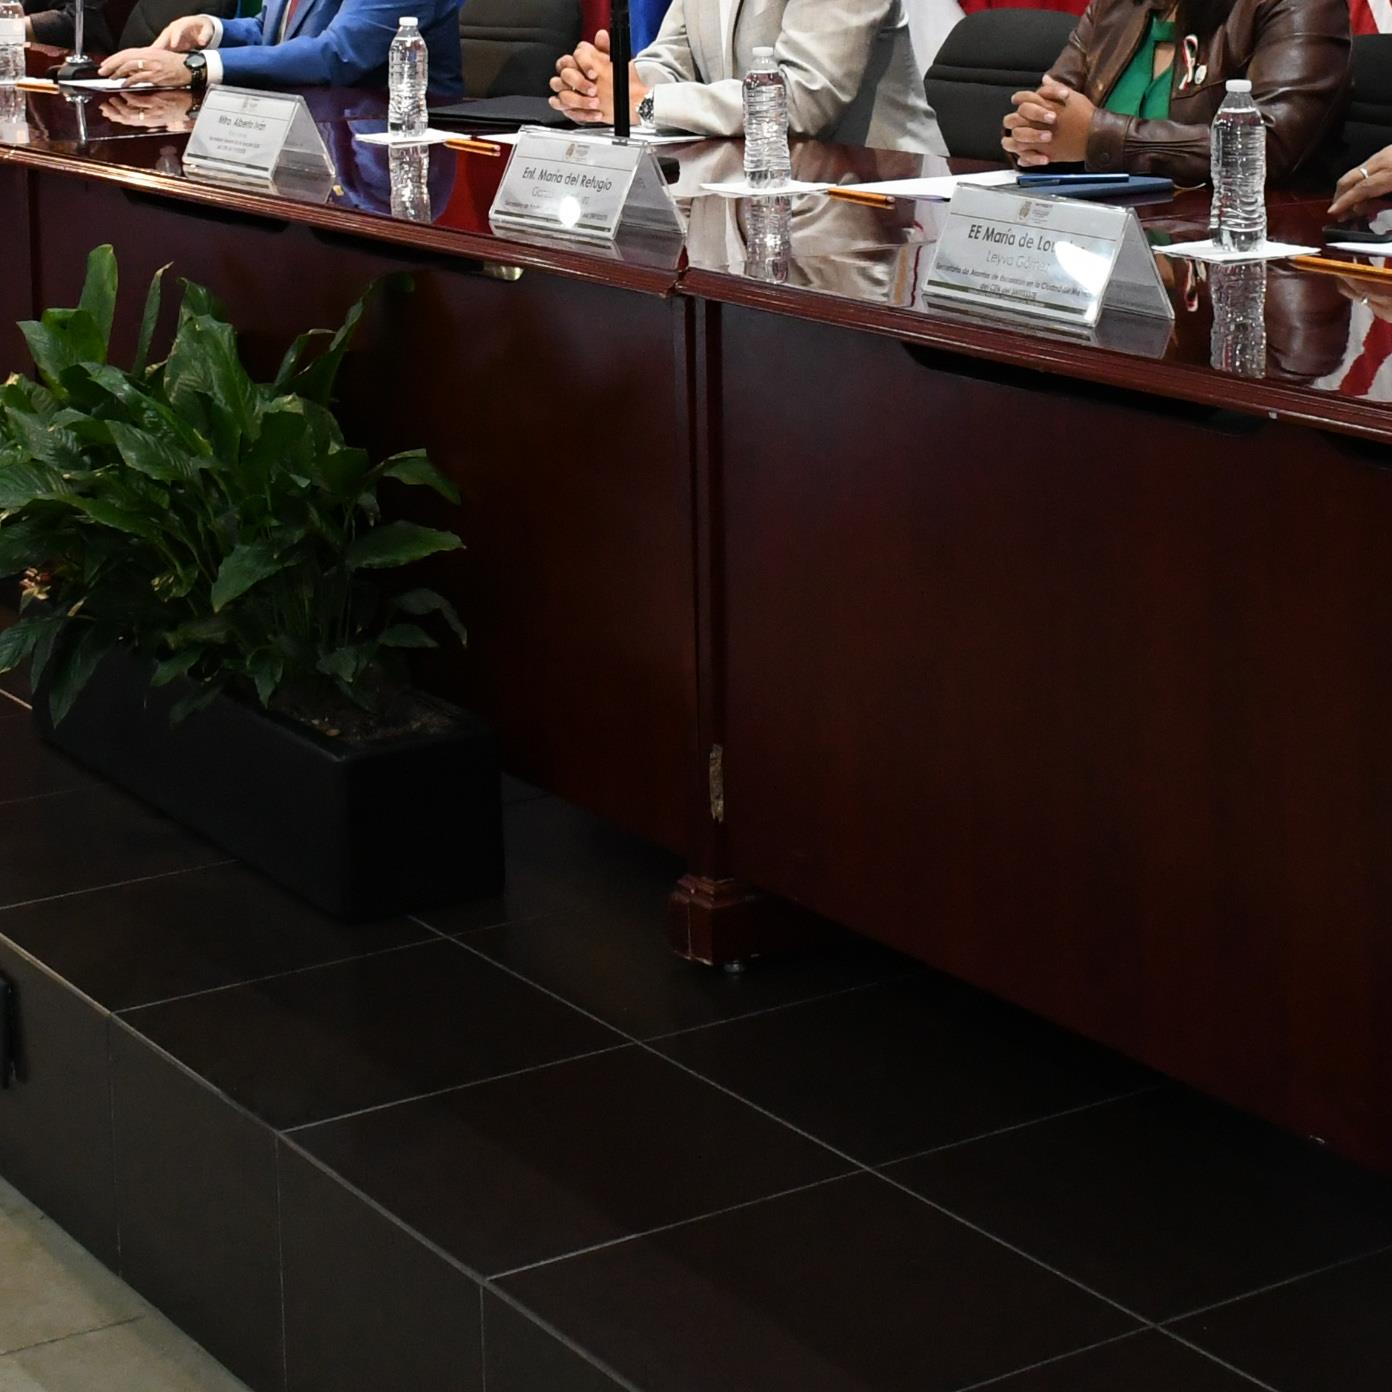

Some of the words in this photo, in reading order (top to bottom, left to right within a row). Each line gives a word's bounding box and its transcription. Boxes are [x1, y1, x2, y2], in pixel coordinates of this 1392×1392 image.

[564, 172, 580, 186] del
[580, 175, 612, 192] Refugio
[968, 224, 982, 240] EE
[982, 226, 1016, 246] María
[1018, 232, 1034, 249] de
